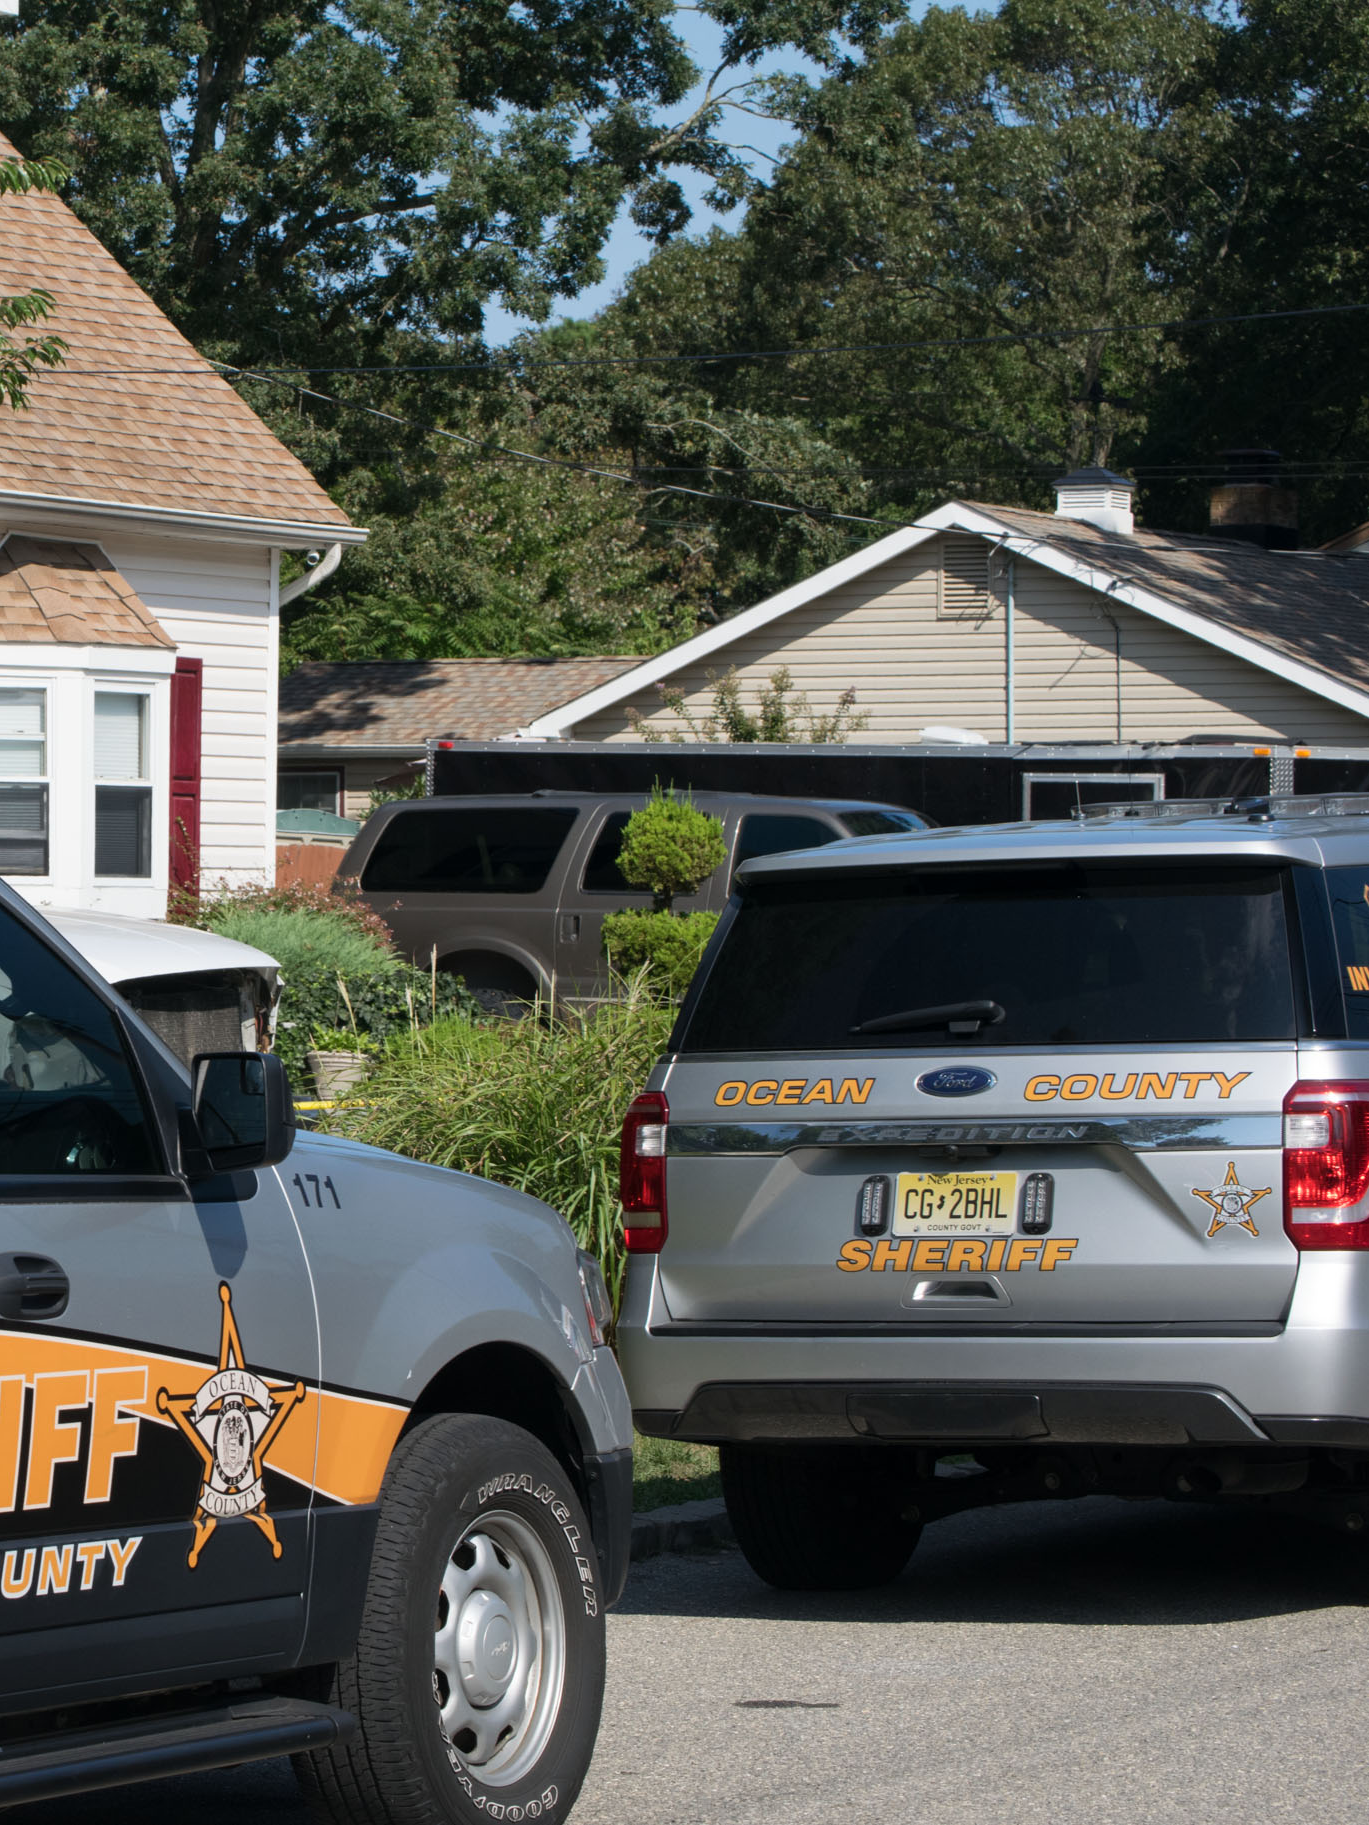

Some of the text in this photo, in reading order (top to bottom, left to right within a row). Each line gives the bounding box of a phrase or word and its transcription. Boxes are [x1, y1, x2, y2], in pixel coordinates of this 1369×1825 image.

[714, 1077, 876, 1107] OCEAN
[1024, 1071, 1253, 1101] COUNTY
[817, 1126, 1088, 1142] EXPEDITION
[293, 1173, 341, 1209] 171
[927, 1174, 988, 1187] New Jersey
[904, 1187, 1007, 1219] CG 2BHL
[836, 1238, 1078, 1272] SHERIFF
[208, 1372, 258, 1398] OCEAN
[205, 1486, 257, 1515] COUNTY
[477, 1473, 598, 1617] WRANGLER
